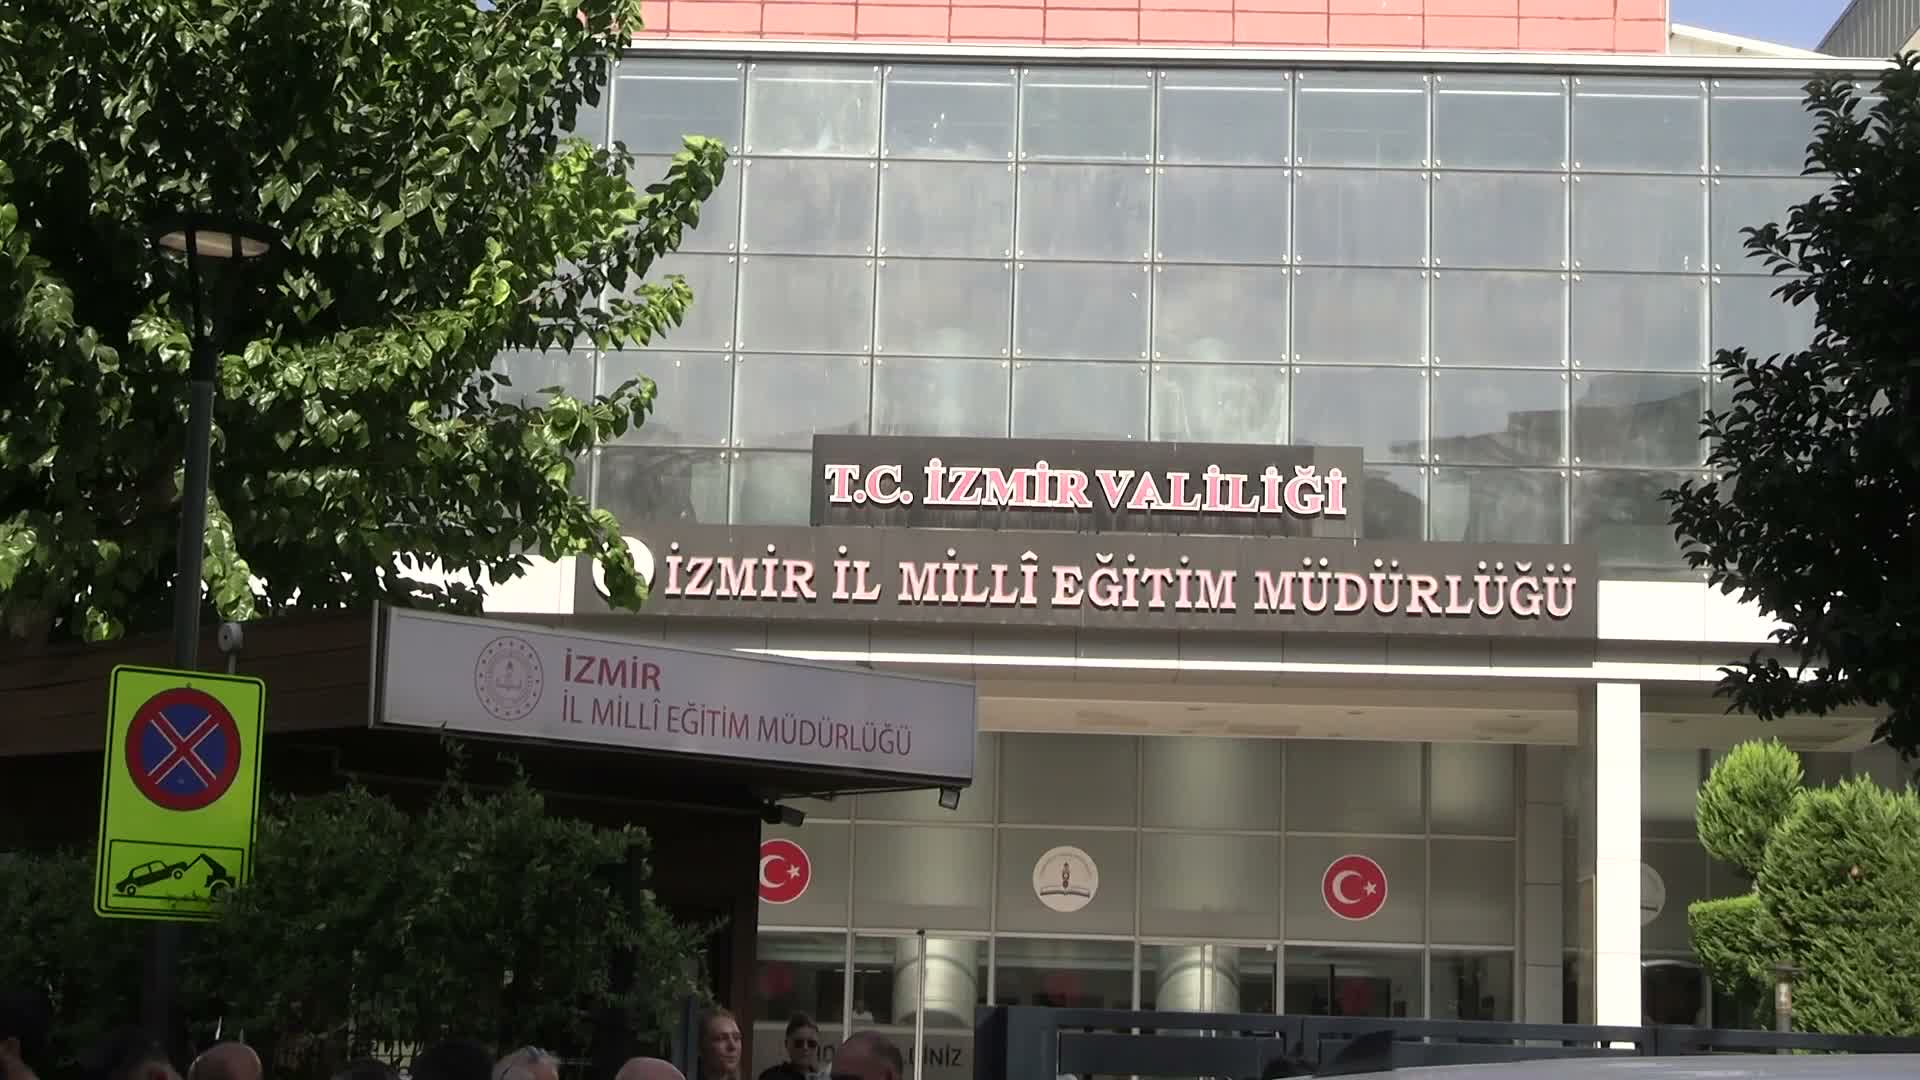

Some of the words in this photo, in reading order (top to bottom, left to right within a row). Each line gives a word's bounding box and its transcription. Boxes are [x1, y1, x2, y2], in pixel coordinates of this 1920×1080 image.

[824, 463, 913, 505] T.C.
[922, 457, 1093, 509] İZMİR
[1095, 464, 1348, 516] VALİLİĞİ
[664, 541, 817, 600] İZMİR
[831, 544, 882, 602] İL
[897, 547, 1039, 606] MİLLÎ
[1051, 552, 1237, 610] EĞİTİM
[1253, 557, 1577, 617] MÜDÜRLÜĞÜ
[564, 647, 661, 691] İZMİR
[562, 688, 583, 724] İL
[591, 695, 662, 732] MİLLÎ
[666, 701, 750, 741] EĞİTİM
[757, 712, 913, 756] MÜDÜRLÜĞÜ
